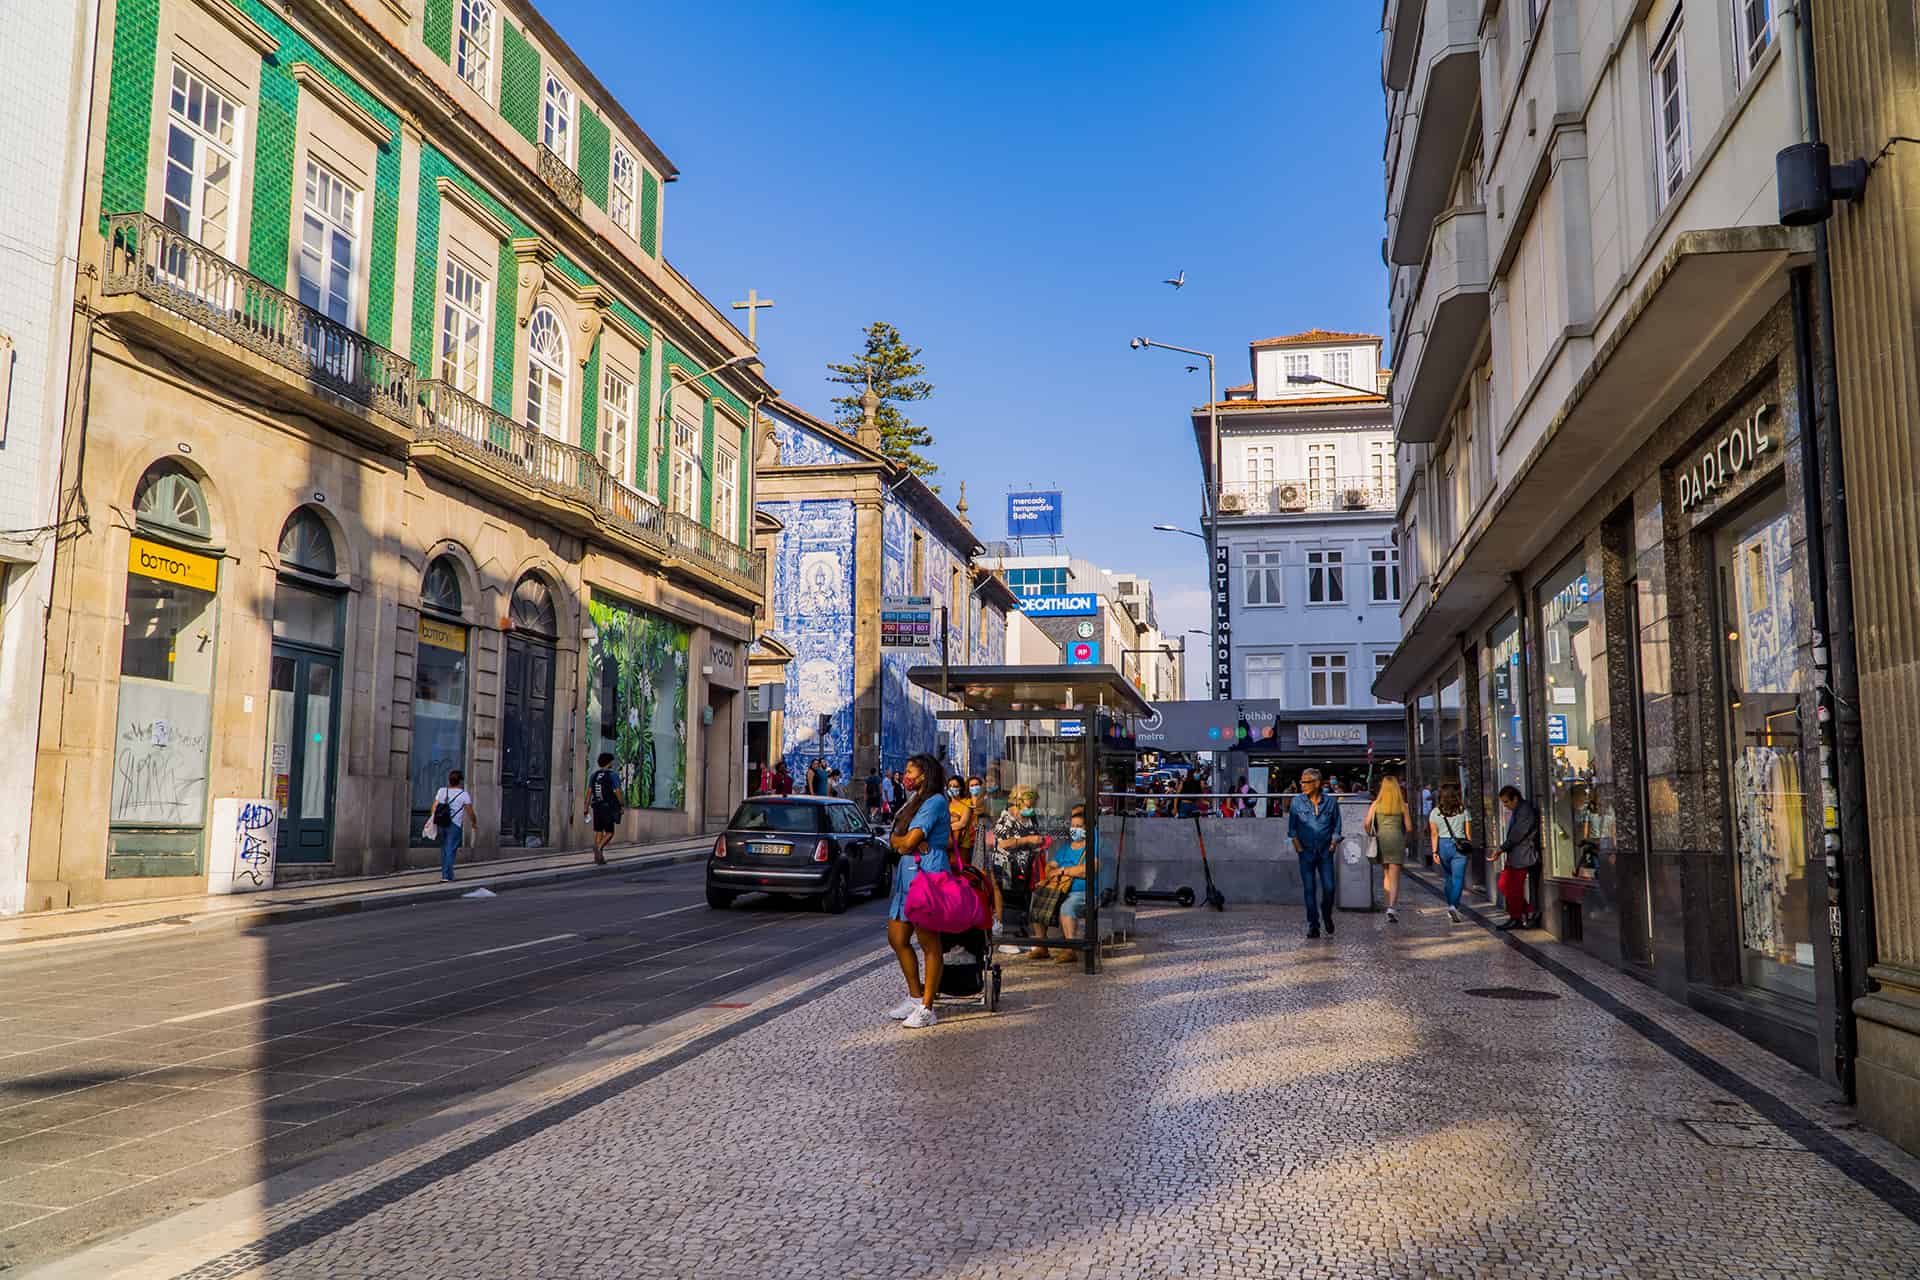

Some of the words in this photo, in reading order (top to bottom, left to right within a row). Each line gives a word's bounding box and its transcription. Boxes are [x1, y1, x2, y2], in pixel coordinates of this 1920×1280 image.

[1679, 404, 1769, 514] PARFOIS
[1012, 497, 1047, 505] mercado
[1012, 504, 1054, 512] temporário
[1216, 548, 1228, 617] HOTEL
[1020, 597, 1091, 611] DECATHLON
[1218, 635, 1230, 700] NORTE
[1138, 732, 1165, 741] metro
